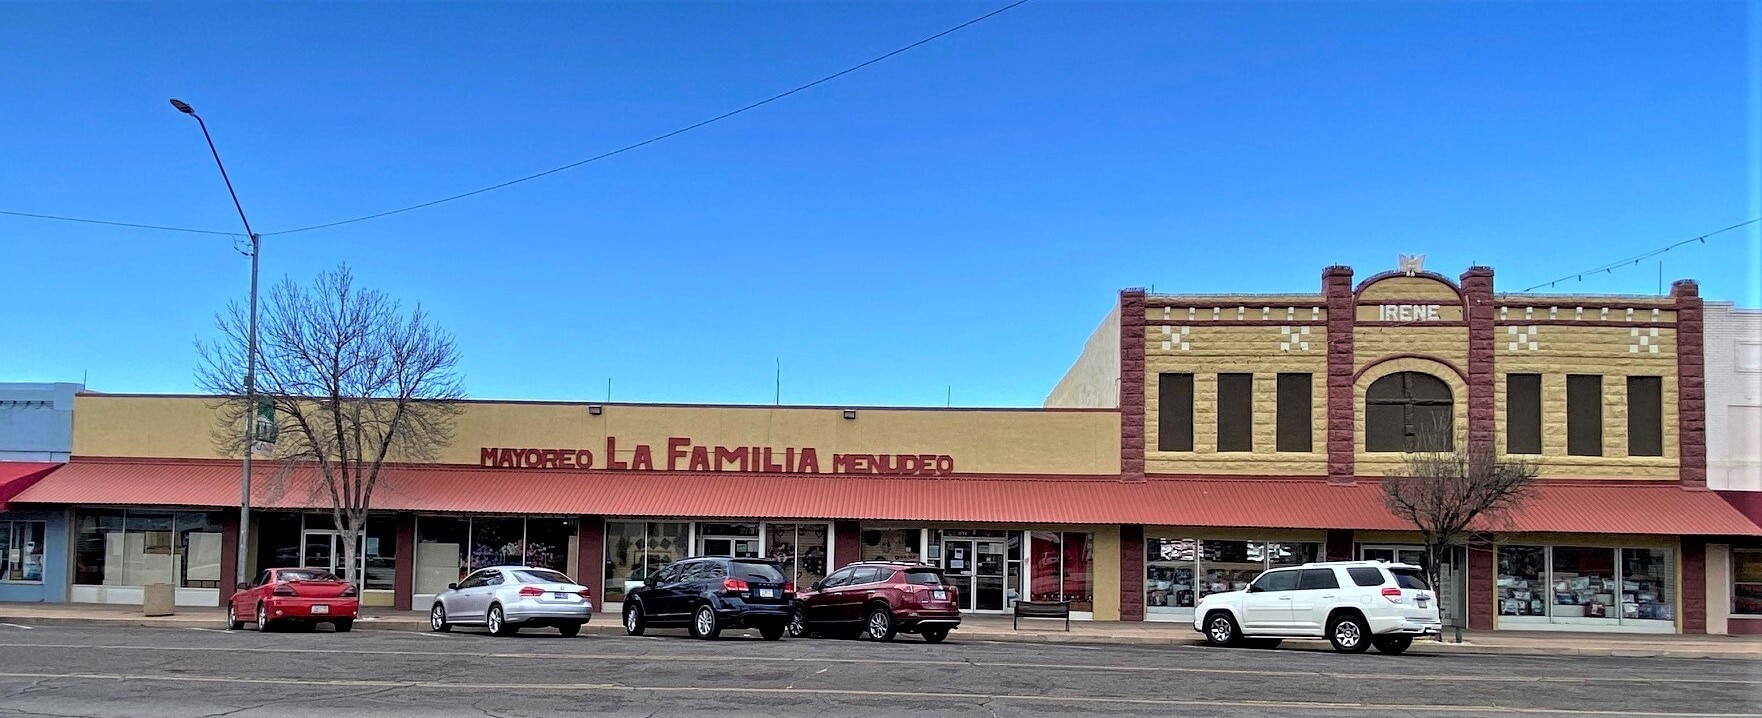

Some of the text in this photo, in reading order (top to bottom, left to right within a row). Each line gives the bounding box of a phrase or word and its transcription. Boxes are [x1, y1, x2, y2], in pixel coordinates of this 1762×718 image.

[1379, 304, 1440, 321] IRENE
[480, 436, 954, 474] MAYOREO LA FAMILIA MENUDEO
